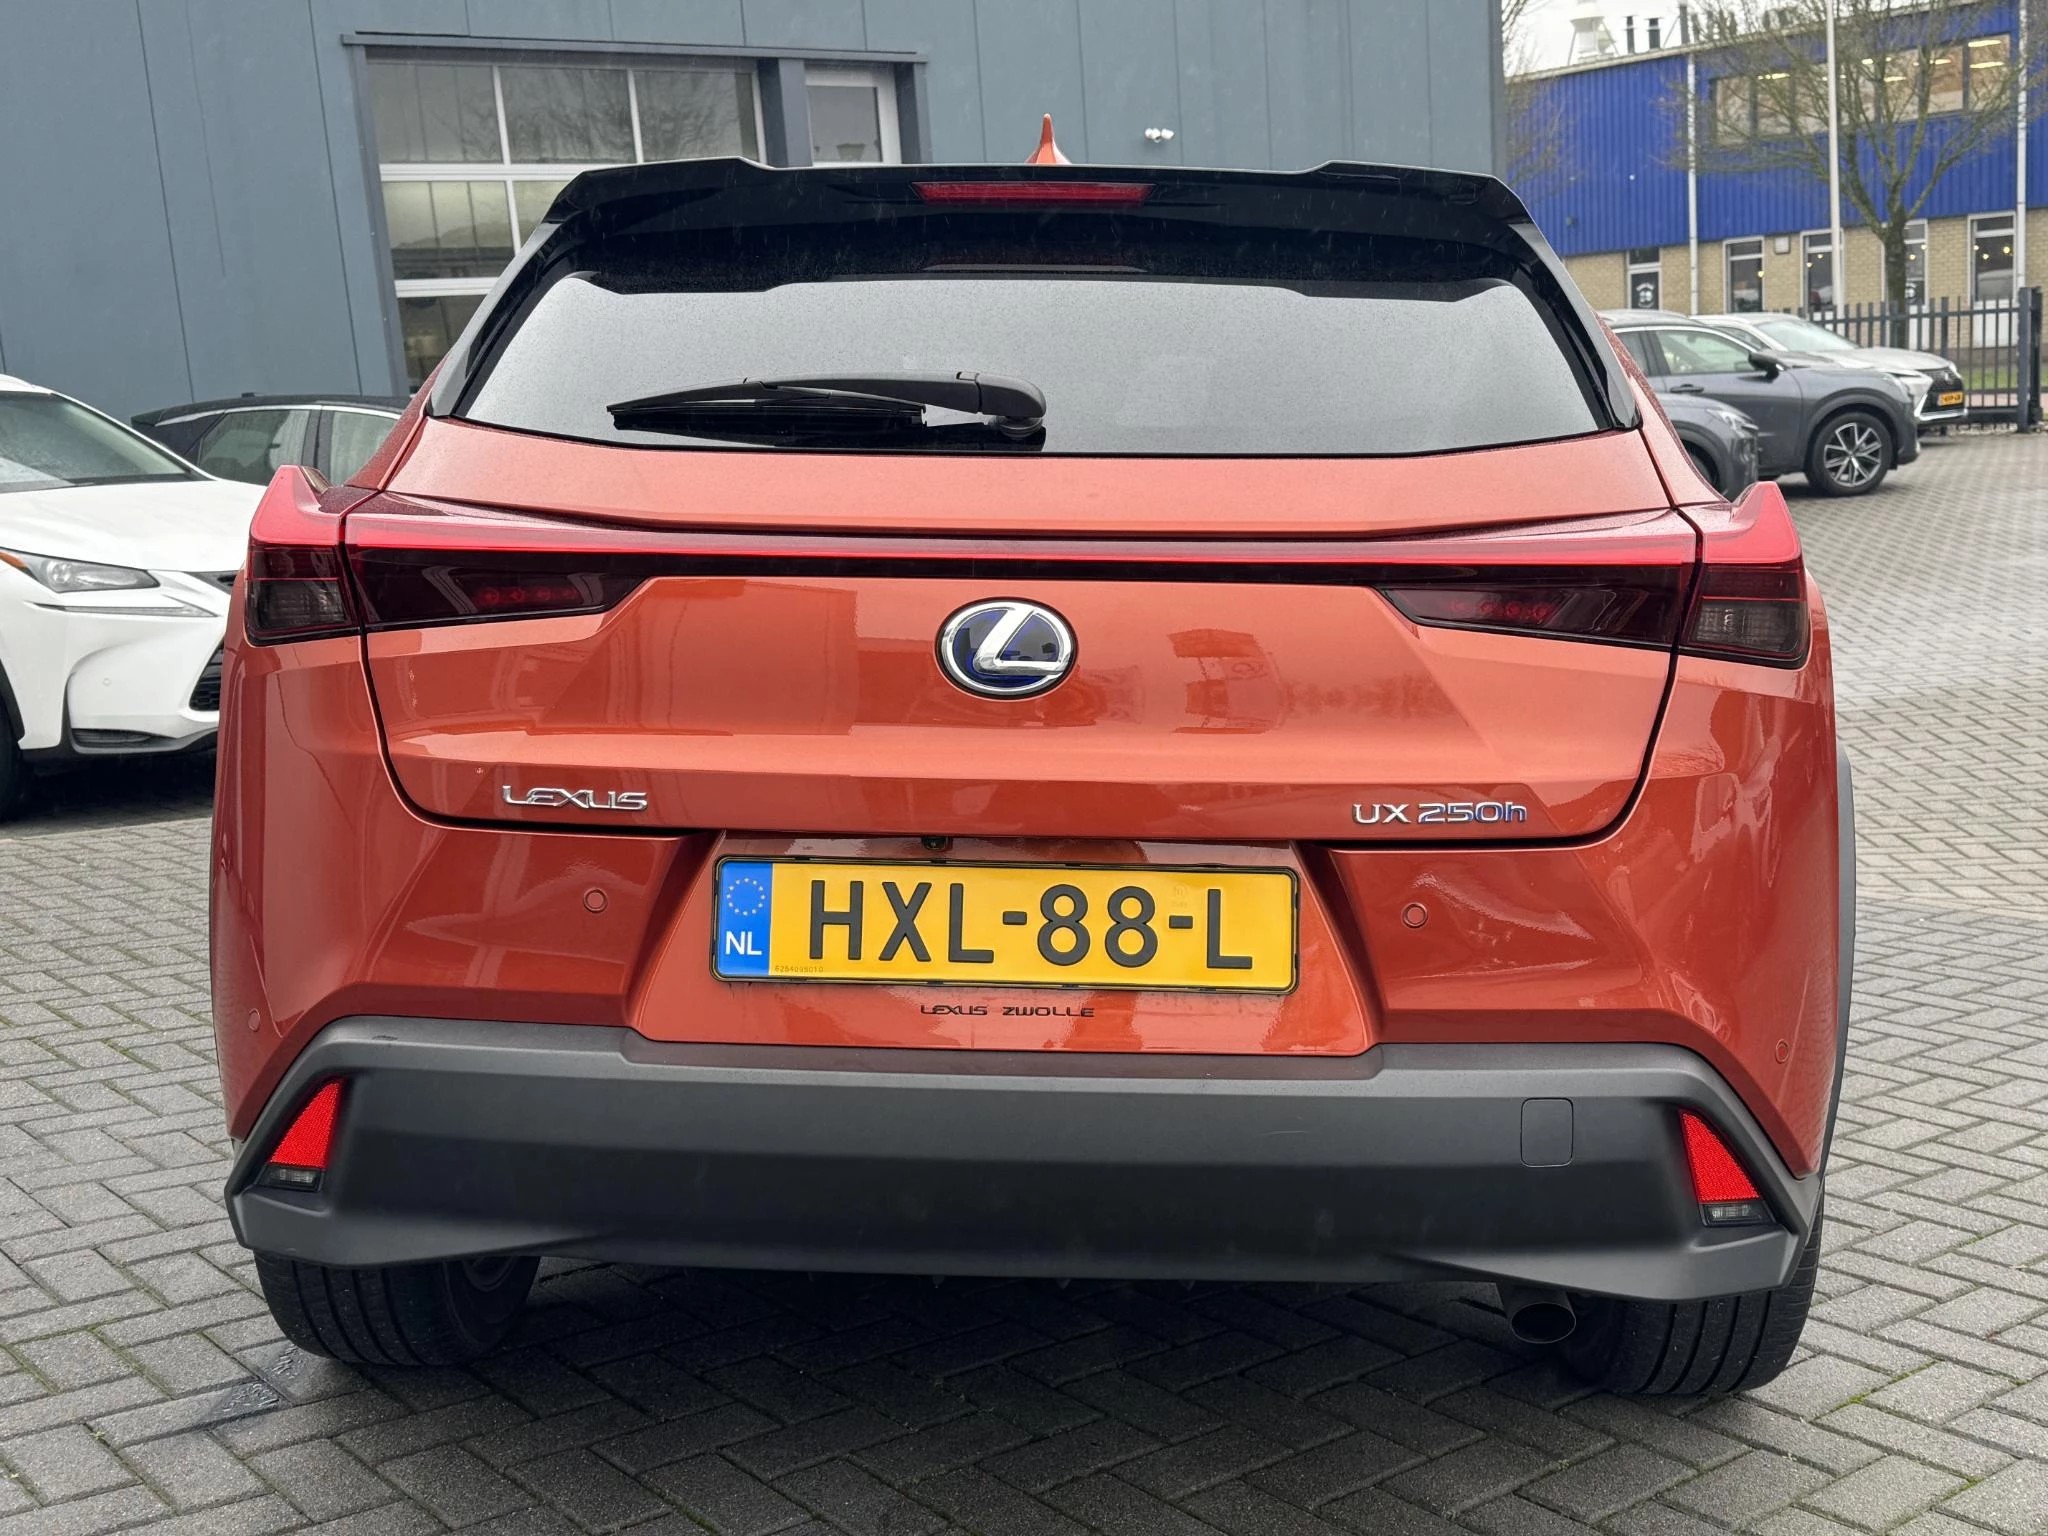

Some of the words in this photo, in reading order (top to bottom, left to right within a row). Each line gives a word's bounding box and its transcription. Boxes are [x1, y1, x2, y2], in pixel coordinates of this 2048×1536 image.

[503, 785, 648, 811] LEXUS
[1352, 803, 1412, 824] UX
[1416, 801, 1527, 824] 250h
[809, 879, 1254, 970] HXL-88-L
[725, 930, 763, 956] NL
[920, 1005, 988, 1016] LEXUS
[1002, 1006, 1095, 1017] ZWOLLE
